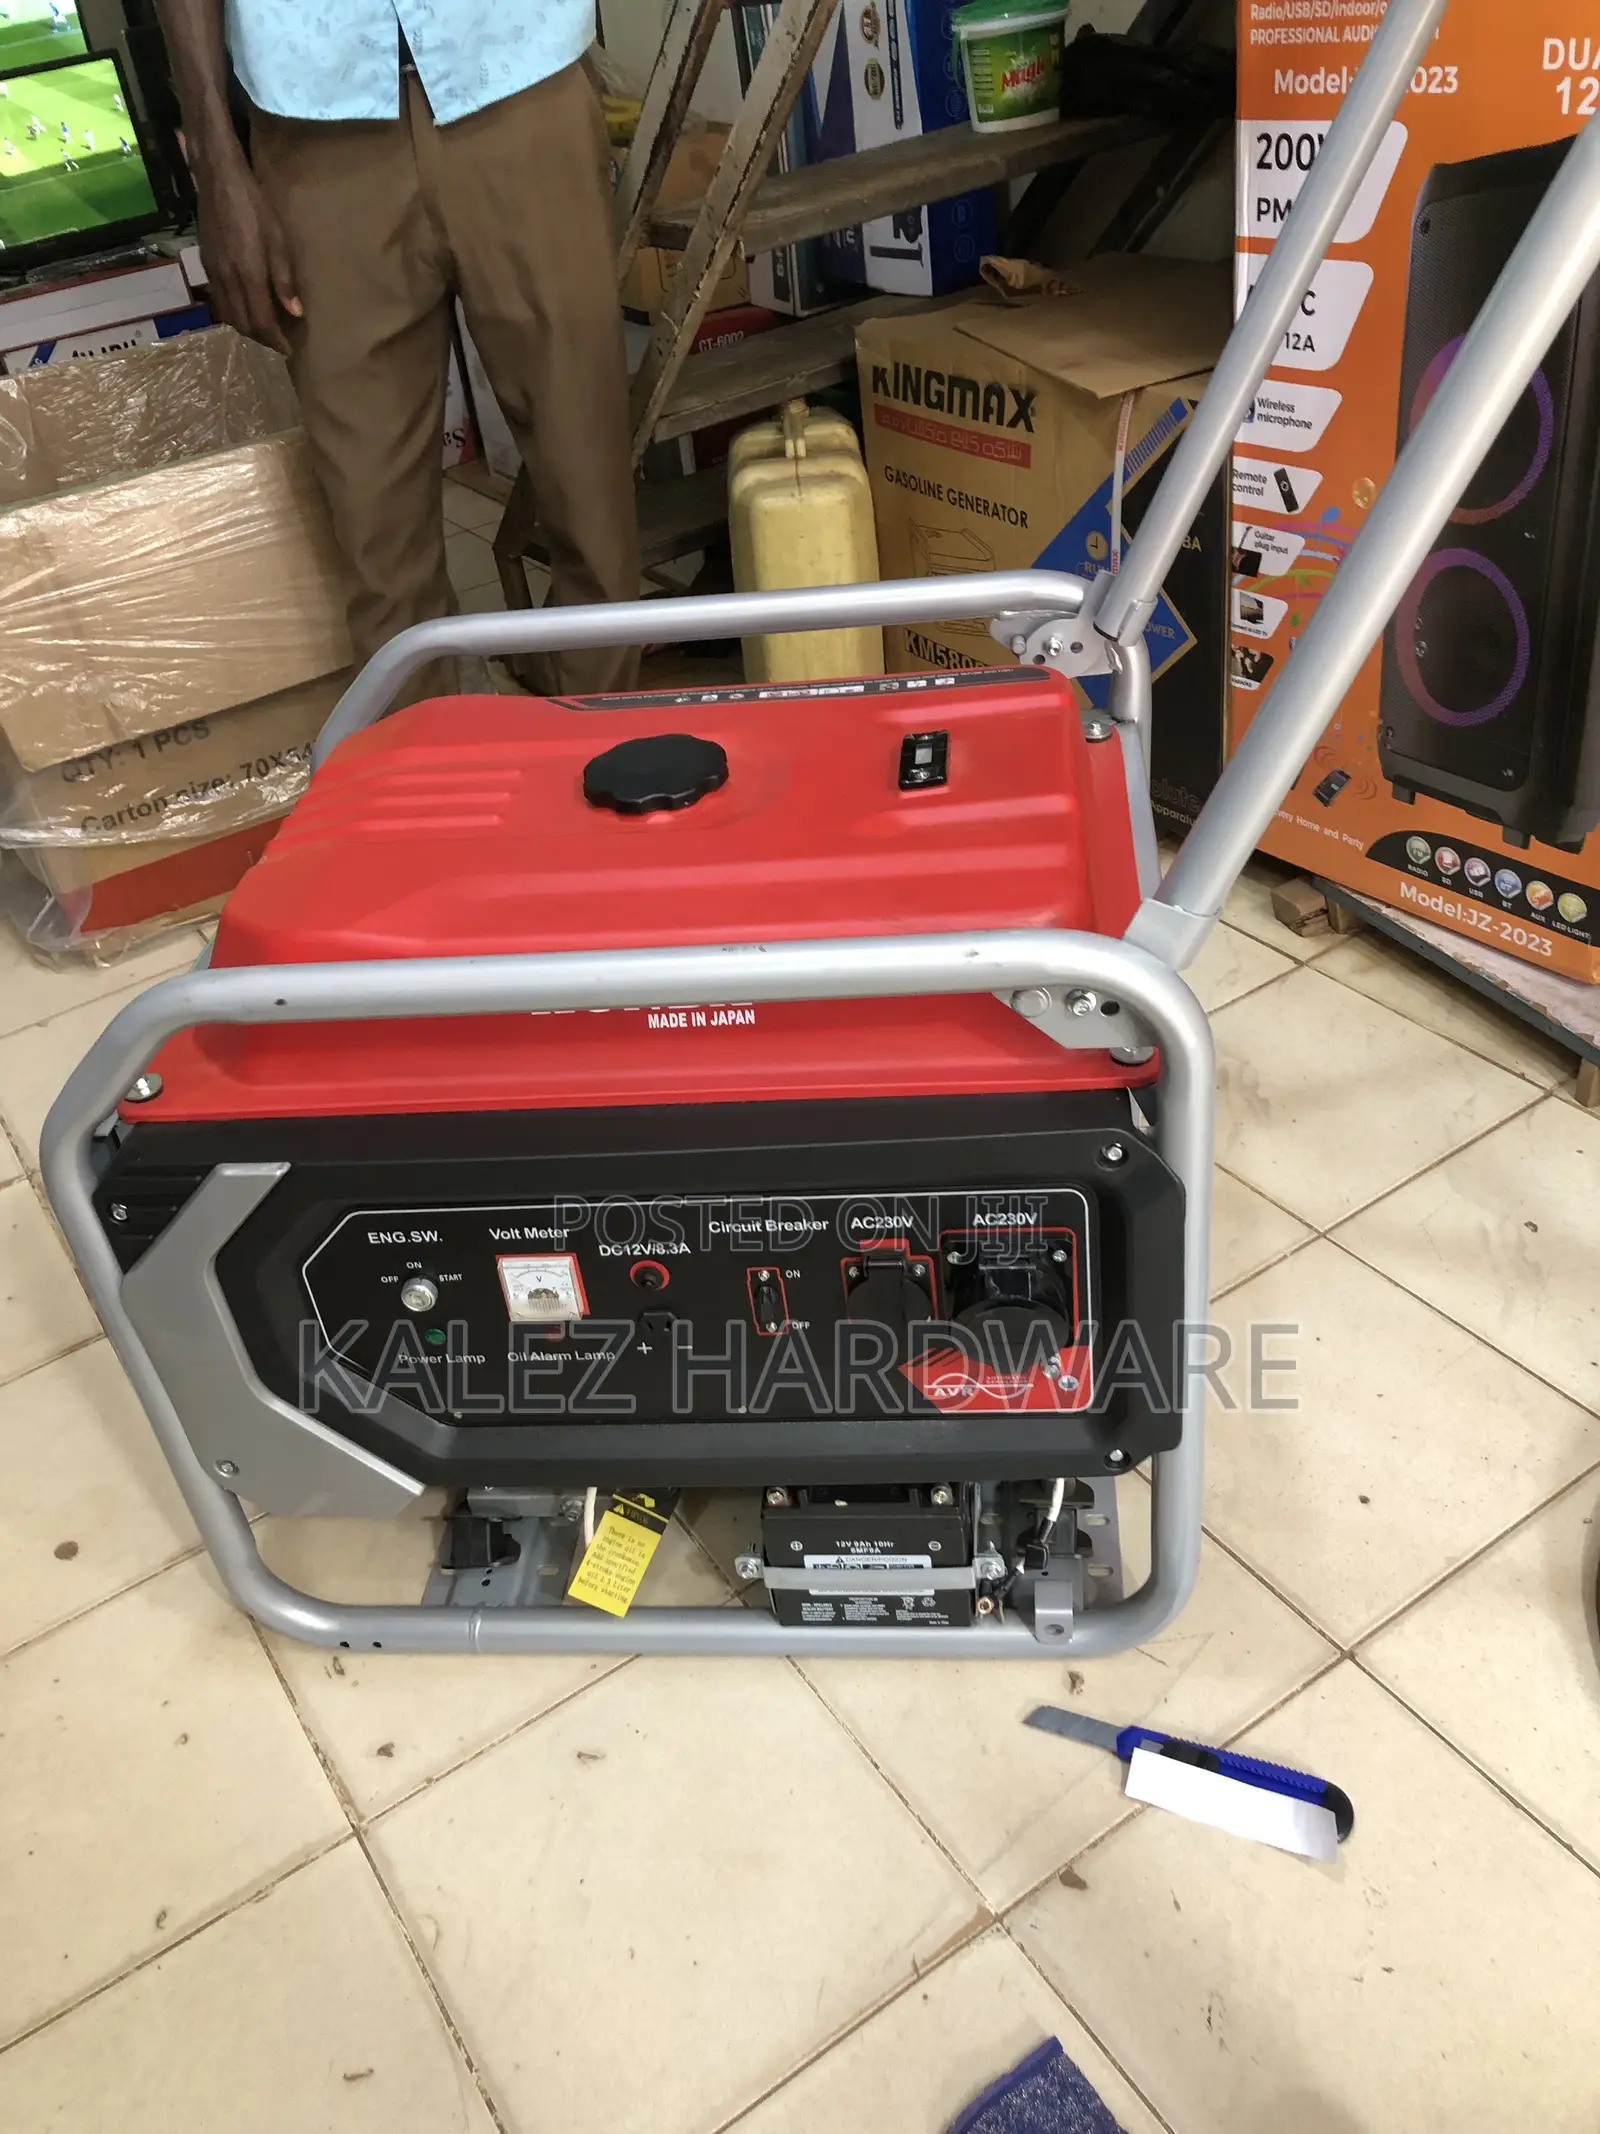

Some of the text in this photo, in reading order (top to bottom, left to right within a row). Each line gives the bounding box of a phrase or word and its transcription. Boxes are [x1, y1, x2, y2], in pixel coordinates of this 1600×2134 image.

[1250, 1, 1388, 21] Radio/USB/SD/Indoor/o
[1250, 25, 1378, 45] PROFESSIONAL AUDI
[1256, 132, 1324, 171] 200
[872, 361, 1036, 434] KINGMAX
[1257, 397, 1296, 414] Wireless
[1257, 412, 1313, 431] microphone
[1233, 468, 1268, 485] Remote
[885, 465, 1028, 529] GASOLINE GENERATOR
[1232, 482, 1264, 497] control
[1254, 530, 1276, 542] Guitar
[1254, 541, 1289, 556] plug input
[1145, 621, 1176, 640] OWER
[153, 720, 211, 753] PCS
[80, 739, 317, 833] Carton size: 70X54
[1296, 815, 1321, 832] Home
[1323, 827, 1339, 839] and
[1342, 833, 1364, 851] Party
[1407, 864, 1429, 877] RADIO
[1400, 881, 1553, 957] Model:JZ-2023
[1530, 912, 1548, 923] AUX
[1552, 920, 1590, 939] LED LIGHT
[648, 1009, 756, 1029] MADE IN JAPAN
[708, 1218, 829, 1234] Circuit Breaker
[850, 1216, 914, 1230] AC230V
[972, 1212, 1038, 1227] AC230V
[367, 1229, 443, 1245] ENG.SW.
[489, 1225, 570, 1241] Volt Meter
[599, 1242, 692, 1257] DC12V/8.3A
[406, 1260, 422, 1269] ON
[380, 1275, 399, 1284] OFF
[438, 1272, 463, 1283] START
[786, 1269, 801, 1279] ON
[791, 1321, 811, 1331] OFF
[398, 1352, 486, 1365] Power Lamp
[507, 1349, 616, 1363] Oil Alarm Lamp
[933, 1384, 975, 1398] AVR
[836, 1540, 852, 1549] 12V
